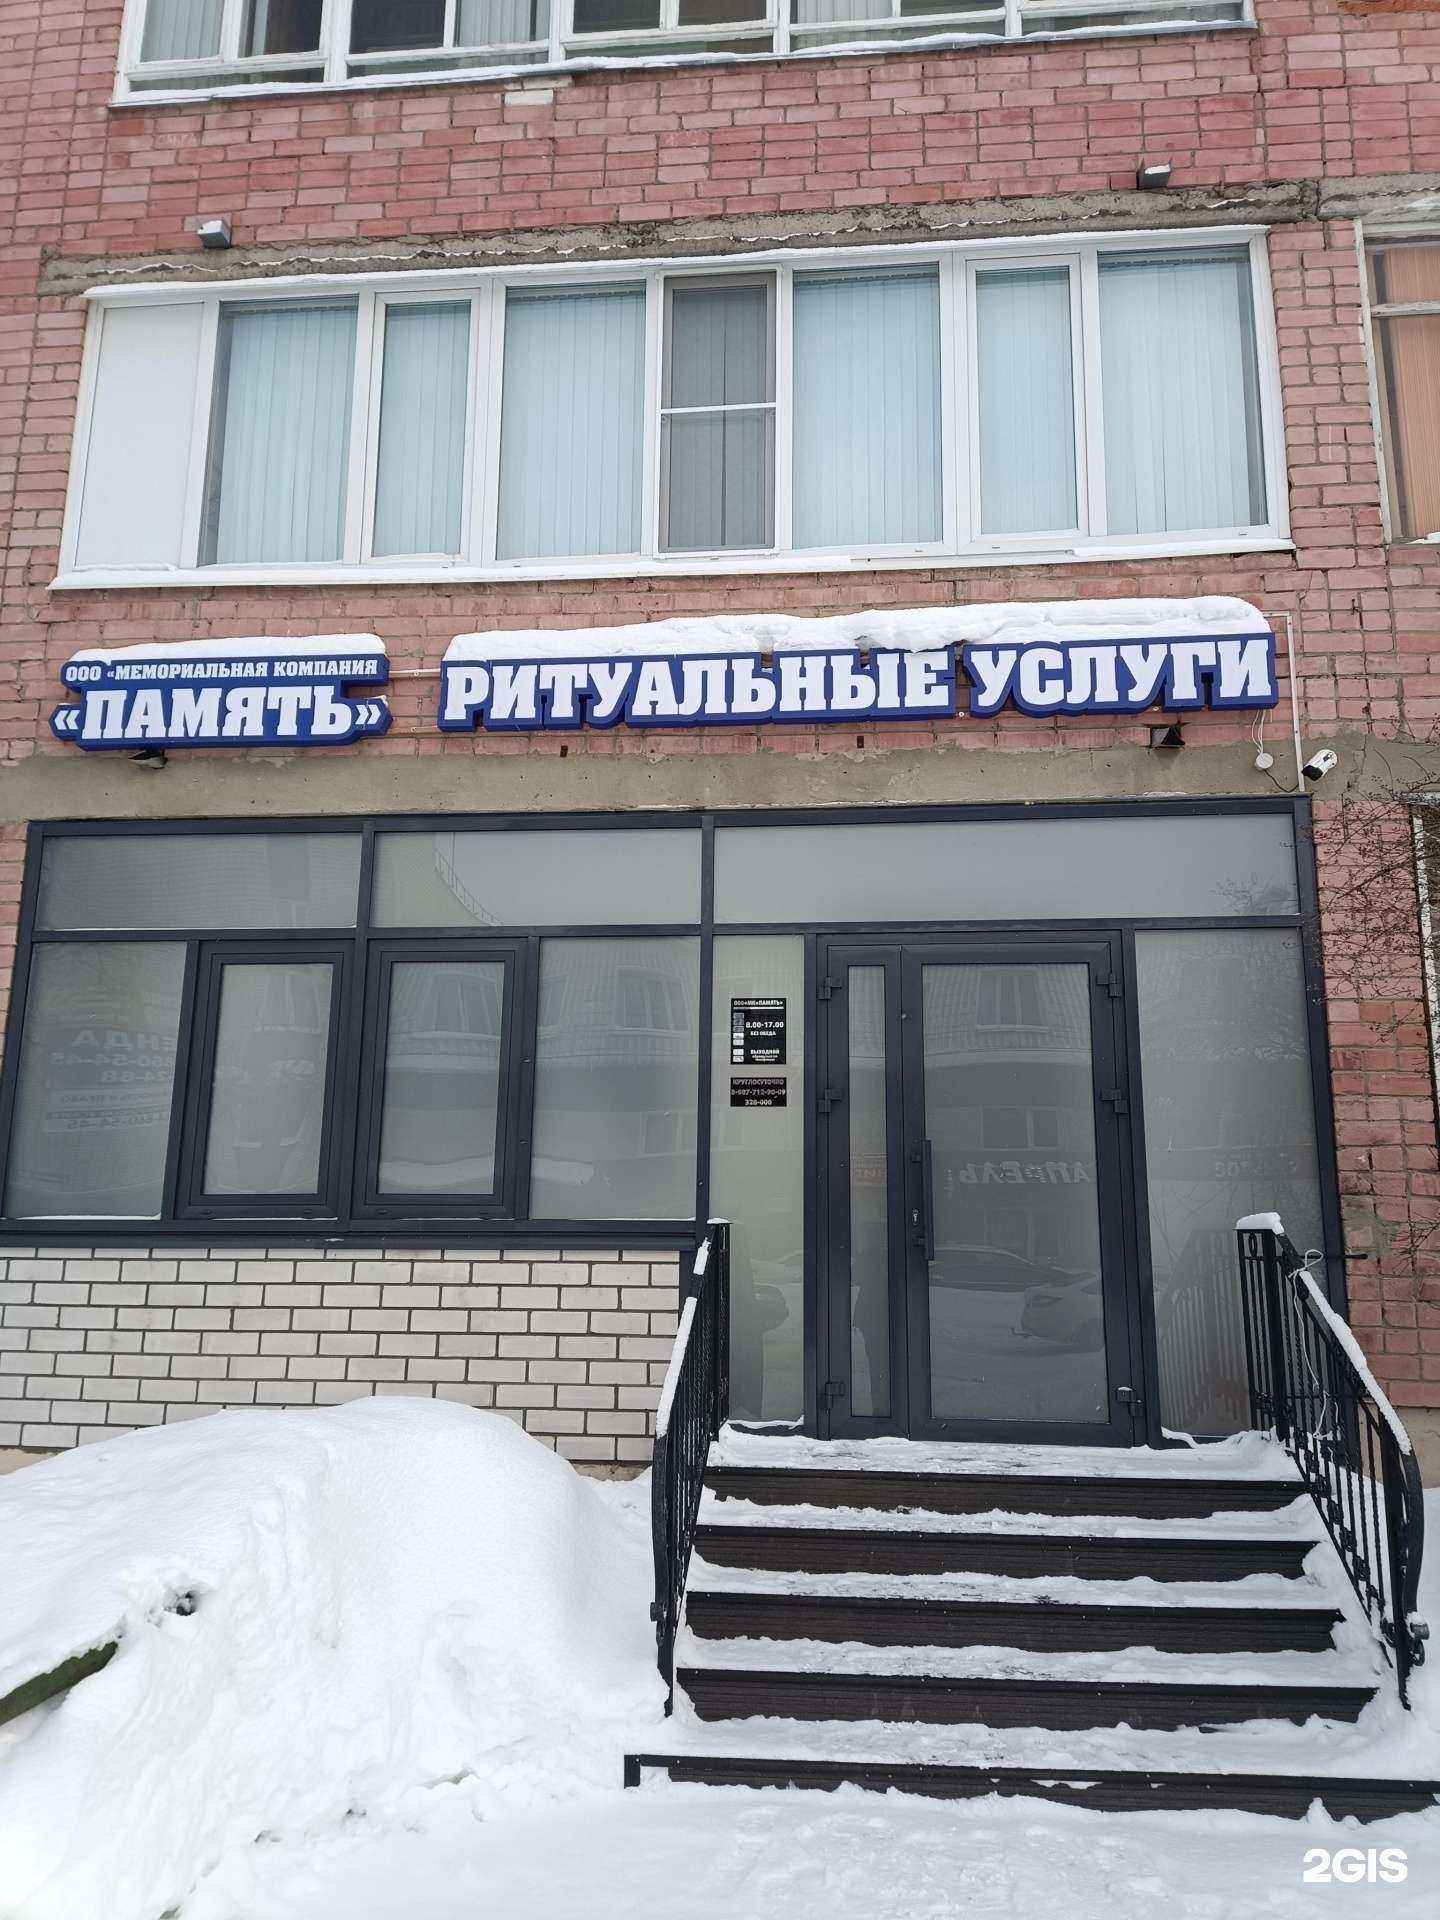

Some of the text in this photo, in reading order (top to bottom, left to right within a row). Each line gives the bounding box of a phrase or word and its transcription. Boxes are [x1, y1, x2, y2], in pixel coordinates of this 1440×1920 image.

[65, 659, 378, 682] ООО «МЕМОРИАЛЬНАЯ КОМПАНИЯ
[444, 639, 1272, 720] РИТУАЛЬНЫЕ УСЛУГИ
[53, 685, 382, 740] «ПАМЯТЬ»
